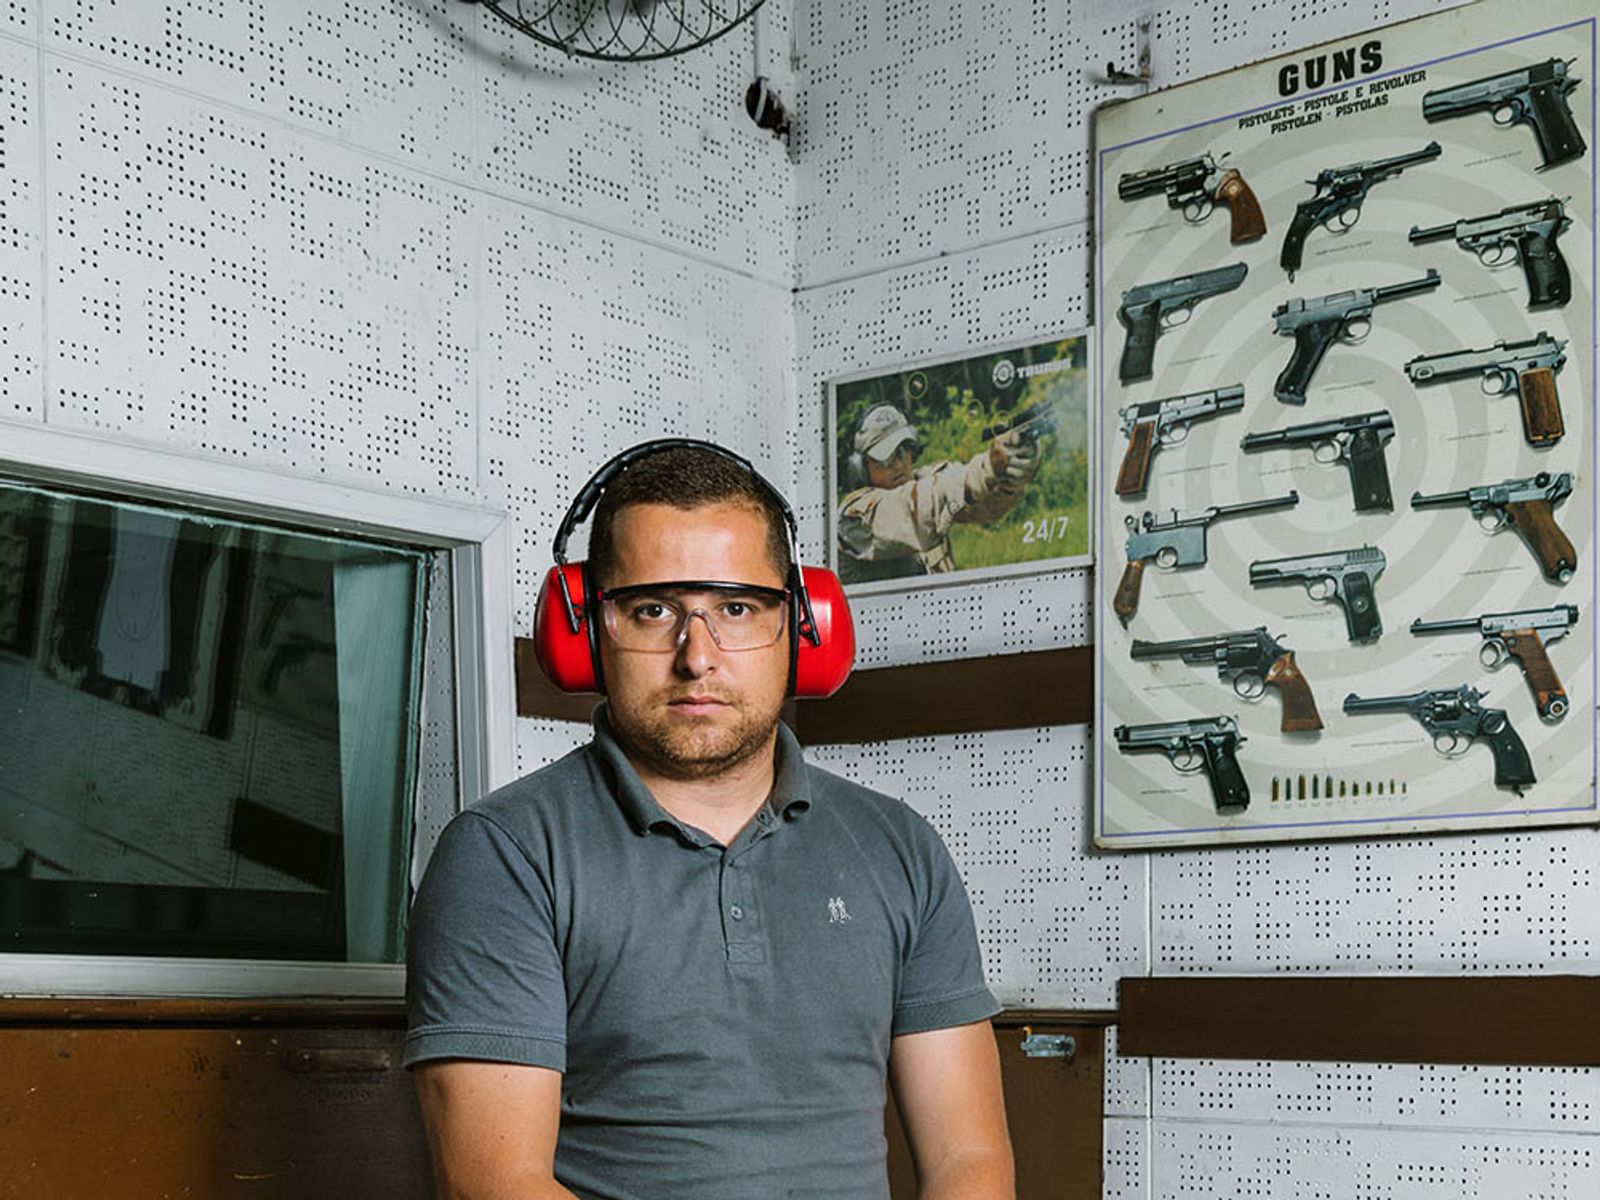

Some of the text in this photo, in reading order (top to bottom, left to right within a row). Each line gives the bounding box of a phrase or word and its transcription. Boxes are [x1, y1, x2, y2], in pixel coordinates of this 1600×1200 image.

[1278, 40, 1383, 97] GUNS
[1238, 105, 1295, 130] PISTOLETS
[1304, 90, 1349, 112] PISTOLE
[1355, 87, 1364, 98] E
[1369, 70, 1427, 94] REVOLVER
[1271, 112, 1322, 135] PISTOLEN
[1336, 94, 1389, 118] PISTOLAS
[1022, 516, 1069, 544] 24/7
